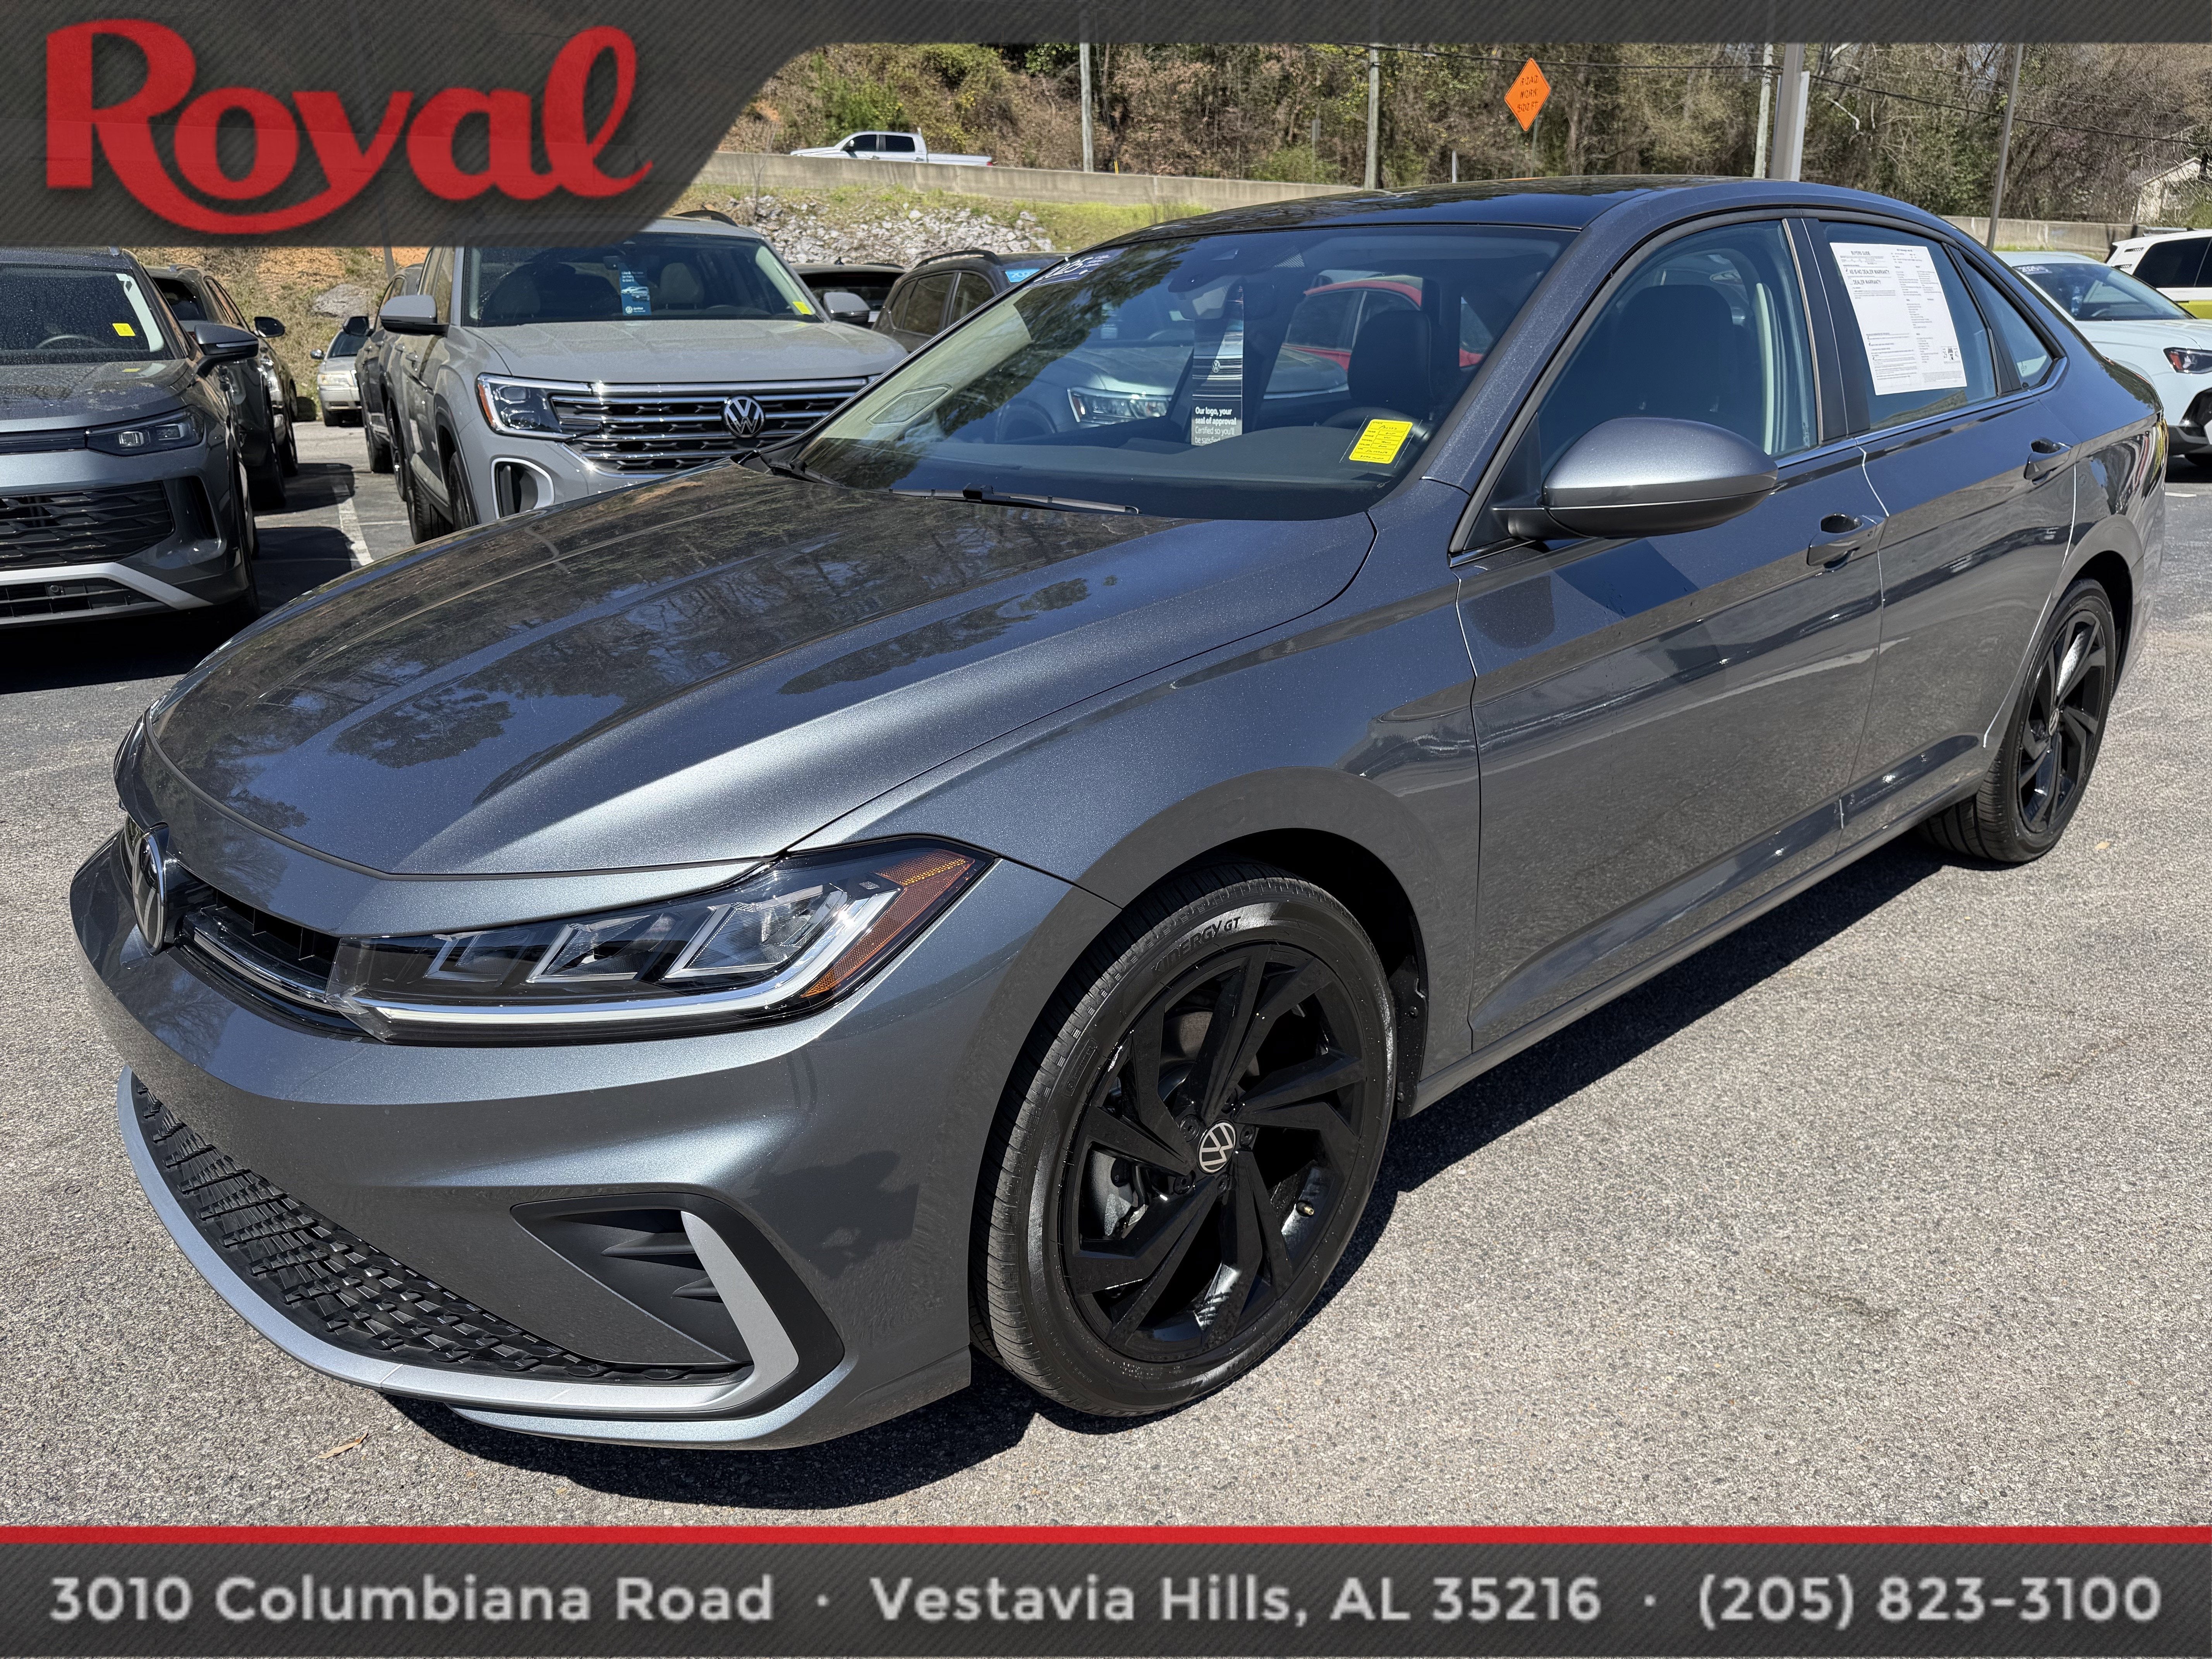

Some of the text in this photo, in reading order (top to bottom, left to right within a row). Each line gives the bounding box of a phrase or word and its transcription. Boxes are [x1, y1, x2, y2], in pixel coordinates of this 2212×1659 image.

[1205, 407, 1219, 416] logo,
[1212, 417, 1237, 426] approval
[1151, 916, 1241, 972] KINERGY GT
